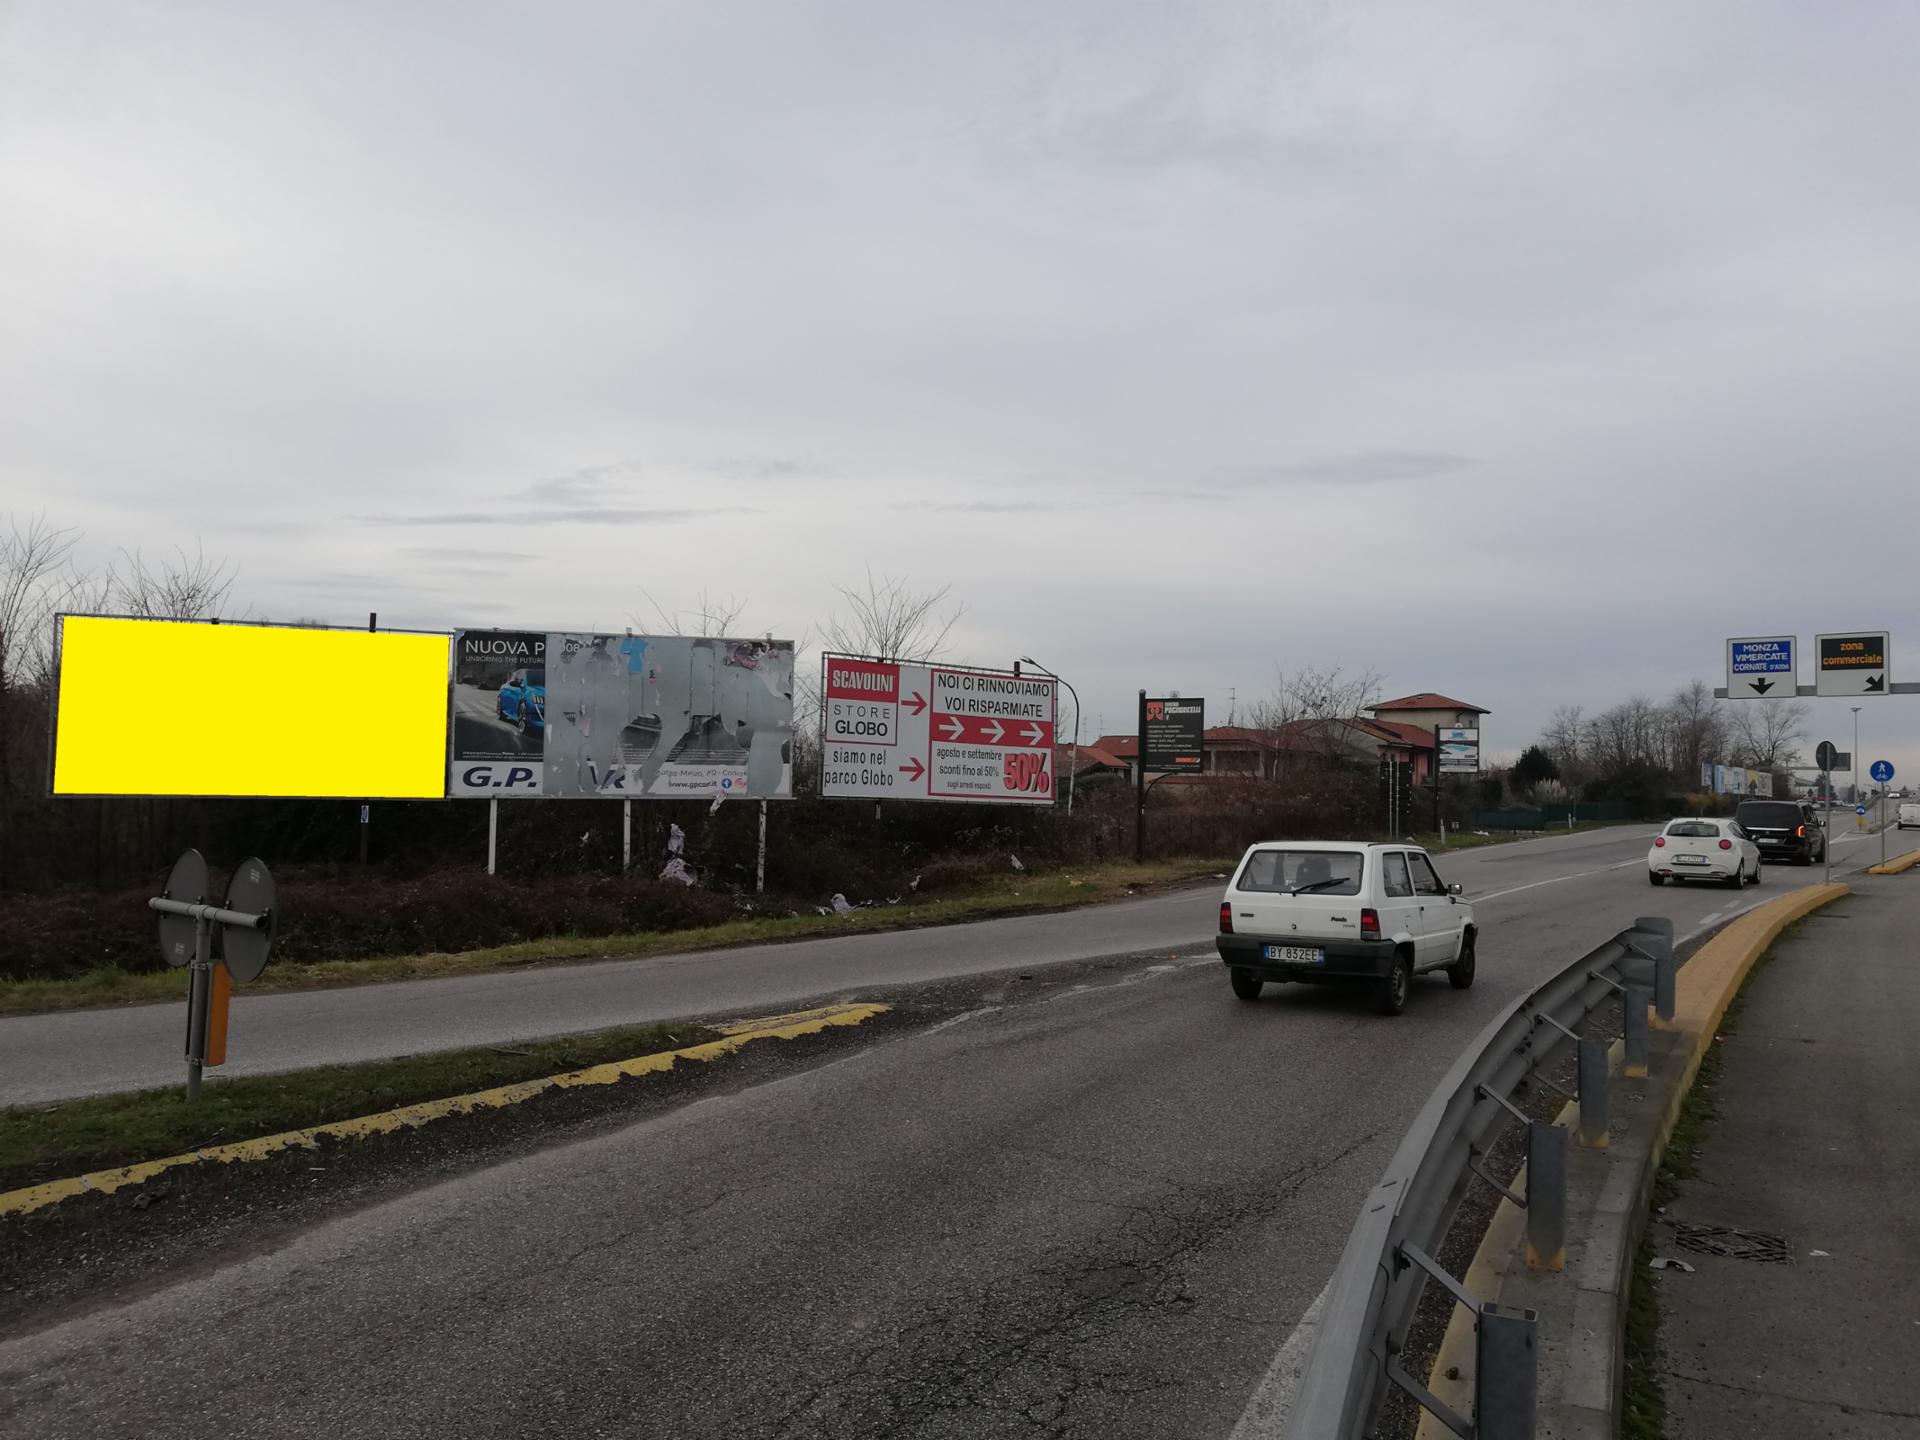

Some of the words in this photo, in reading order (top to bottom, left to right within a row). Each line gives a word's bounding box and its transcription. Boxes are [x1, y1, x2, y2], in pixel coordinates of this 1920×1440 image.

[465, 640, 529, 655] NUOVA
[1743, 643, 1779, 652] MONZA
[1840, 643, 1864, 651] zona
[465, 655, 503, 663] UNBORING
[505, 656, 518, 664] THE
[520, 657, 545, 665] FUTURE
[1735, 652, 1788, 661] VIMERCATE
[1823, 655, 1883, 665] commerciale
[1734, 663, 1768, 671] CORNATE
[832, 669, 894, 692] SCAVOLINI
[938, 674, 959, 688] NOI
[963, 677, 975, 691] CI
[977, 678, 1050, 697] RINNOVIAMO
[833, 704, 891, 719] STORE
[945, 696, 965, 711] VOI
[968, 699, 1043, 717] RISPARMIATE
[835, 720, 888, 736] GLOBO
[833, 747, 866, 764] siamo
[870, 749, 886, 765] nel
[936, 747, 960, 759] agosto
[961, 750, 966, 758] e
[967, 749, 1002, 760] settembre
[462, 766, 538, 788] G.P.
[824, 770, 857, 787] parco
[861, 769, 894, 786] Globo
[939, 764, 961, 775] sconti
[962, 765, 975, 776] fino
[984, 766, 1000, 777] 50%
[1003, 752, 1050, 793] 50%
[1270, 947, 1282, 958] BY
